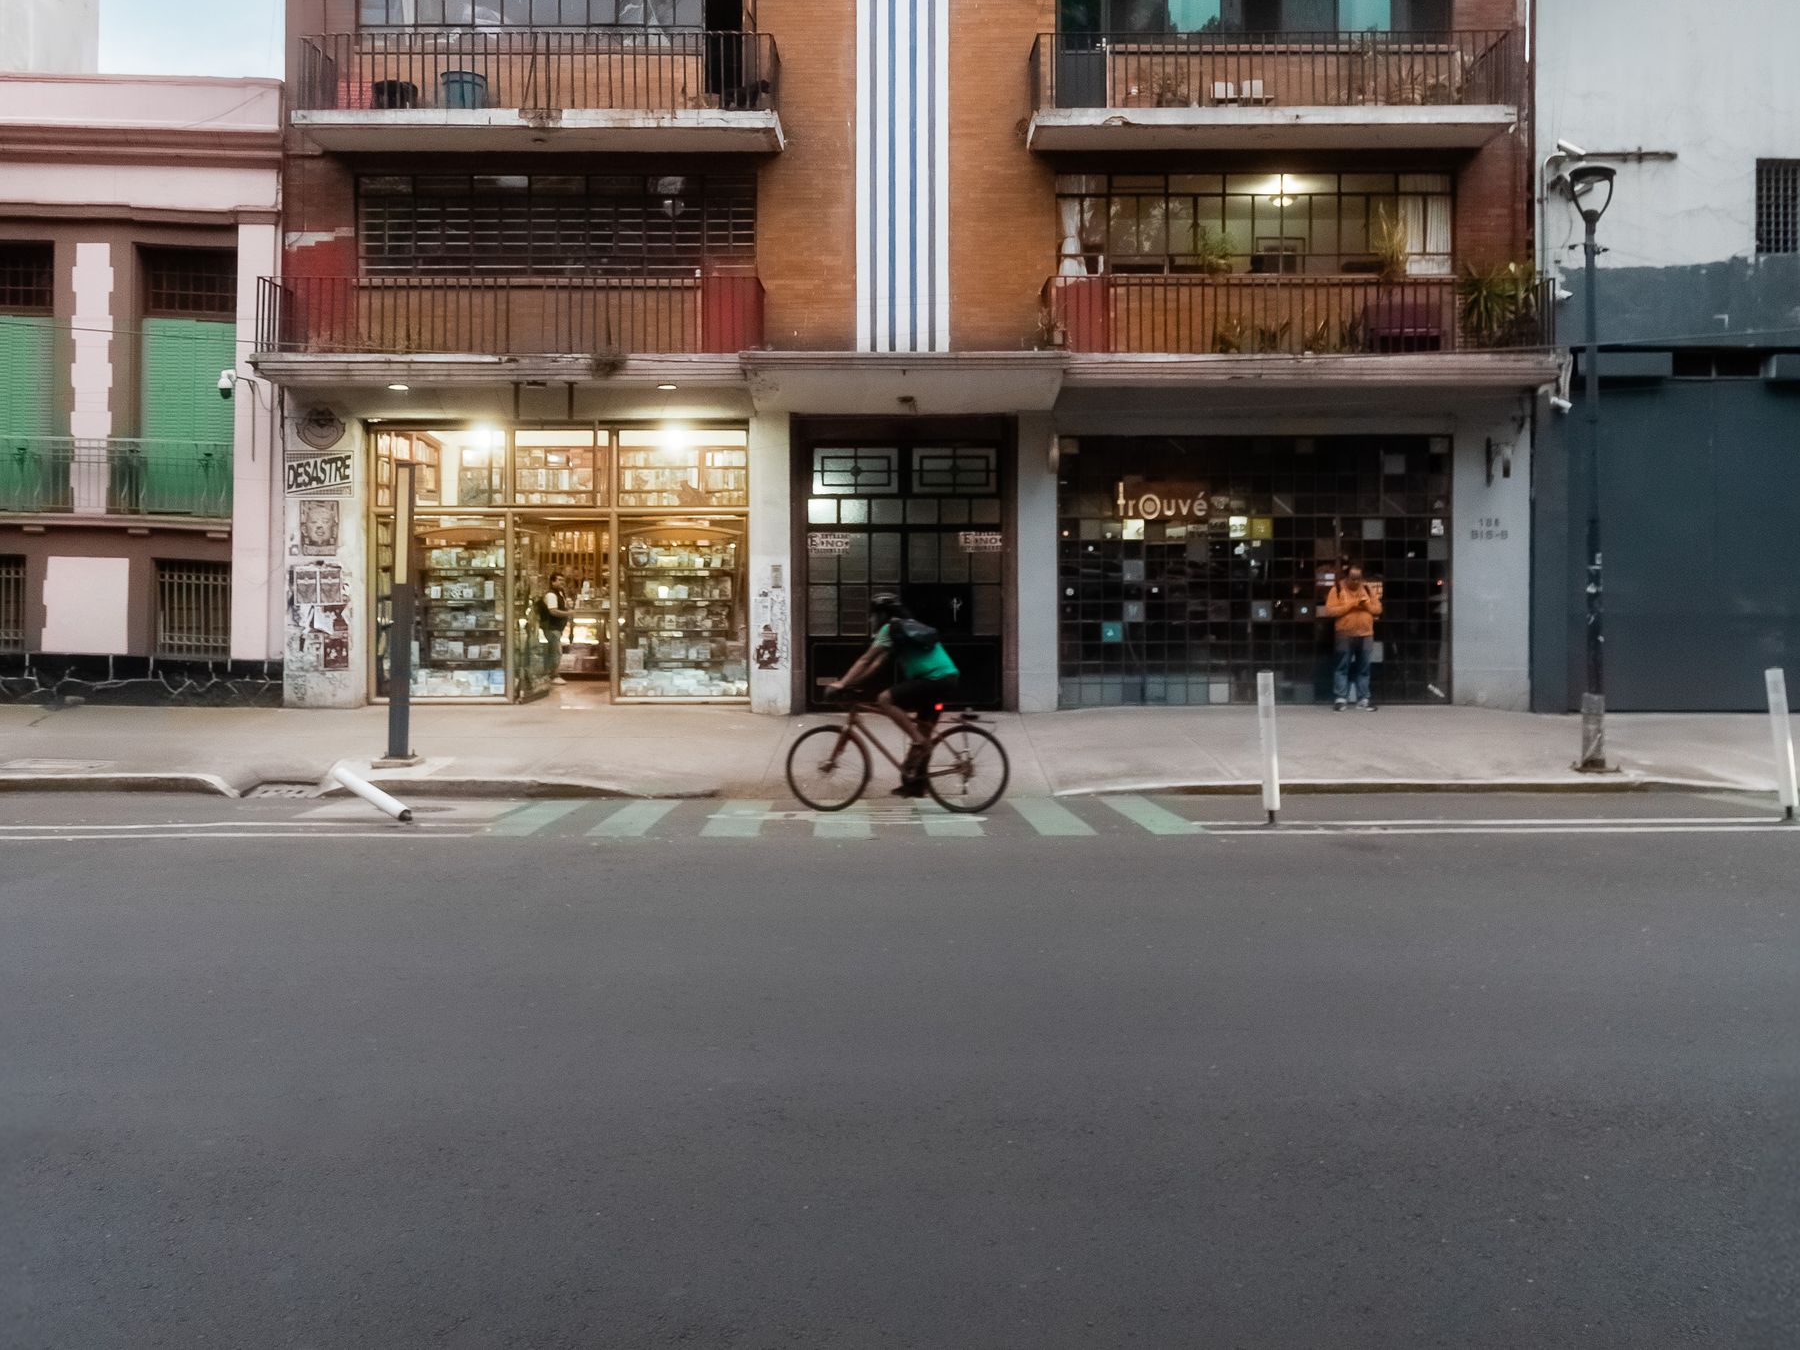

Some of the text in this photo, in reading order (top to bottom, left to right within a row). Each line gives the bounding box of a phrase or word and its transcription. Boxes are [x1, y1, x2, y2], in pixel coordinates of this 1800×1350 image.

[287, 454, 352, 489] DESASTRE
[1117, 481, 1208, 520] trouvé
[825, 540, 844, 548] NO
